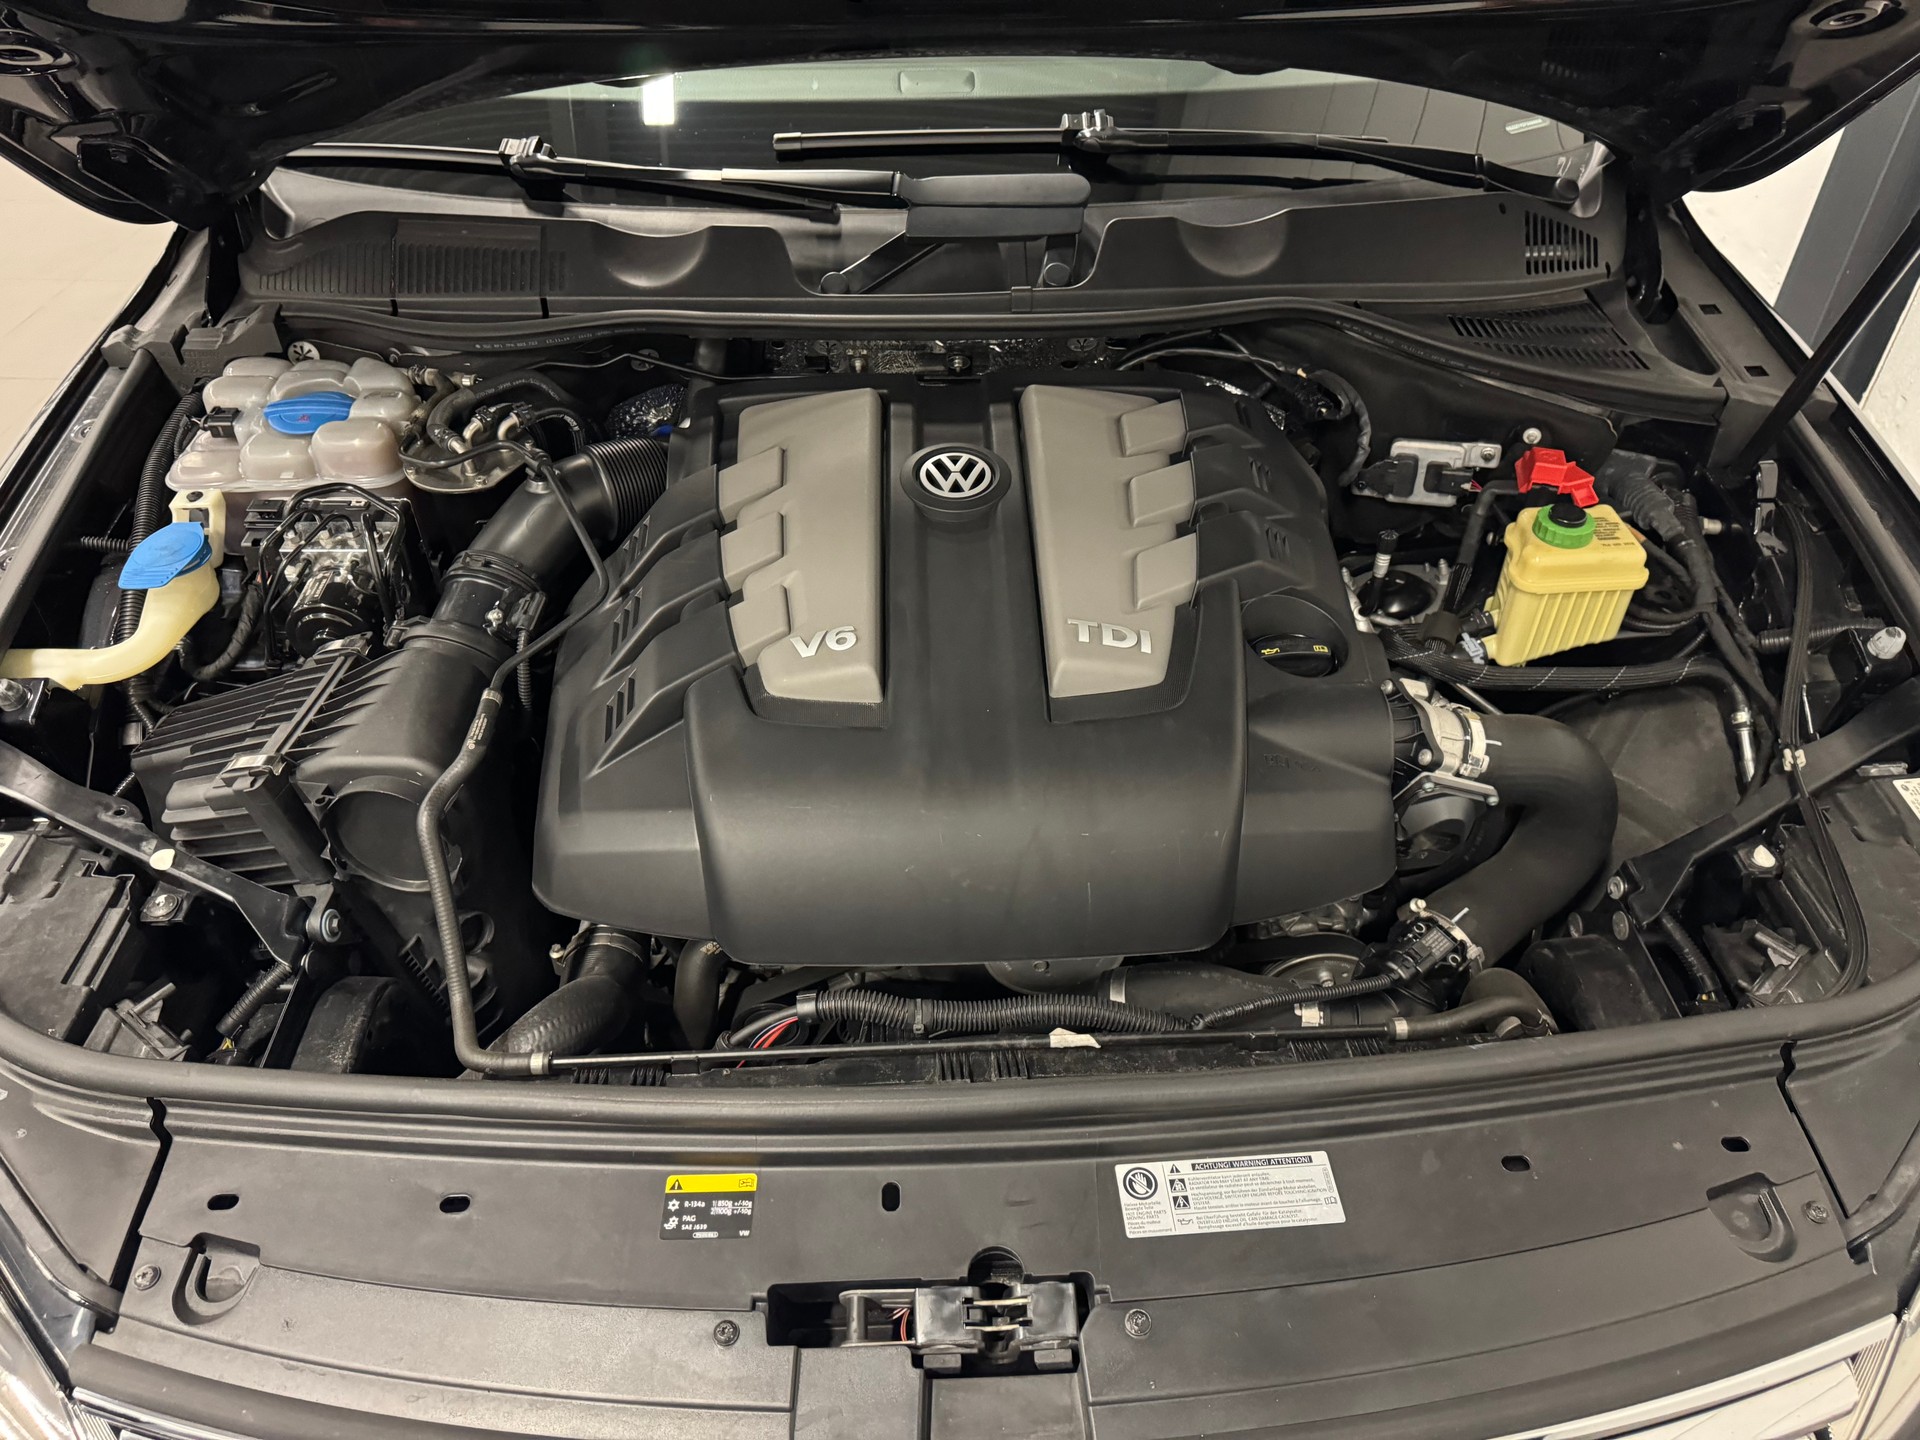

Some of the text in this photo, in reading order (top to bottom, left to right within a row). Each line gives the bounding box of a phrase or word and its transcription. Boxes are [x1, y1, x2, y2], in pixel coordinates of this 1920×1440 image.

[790, 625, 858, 659] V6
[1067, 618, 1153, 654] TDI
[1194, 1156, 1311, 1170] ACHTUNG! WARNING! ATTENTION!
[684, 1200, 706, 1208] R-134a
